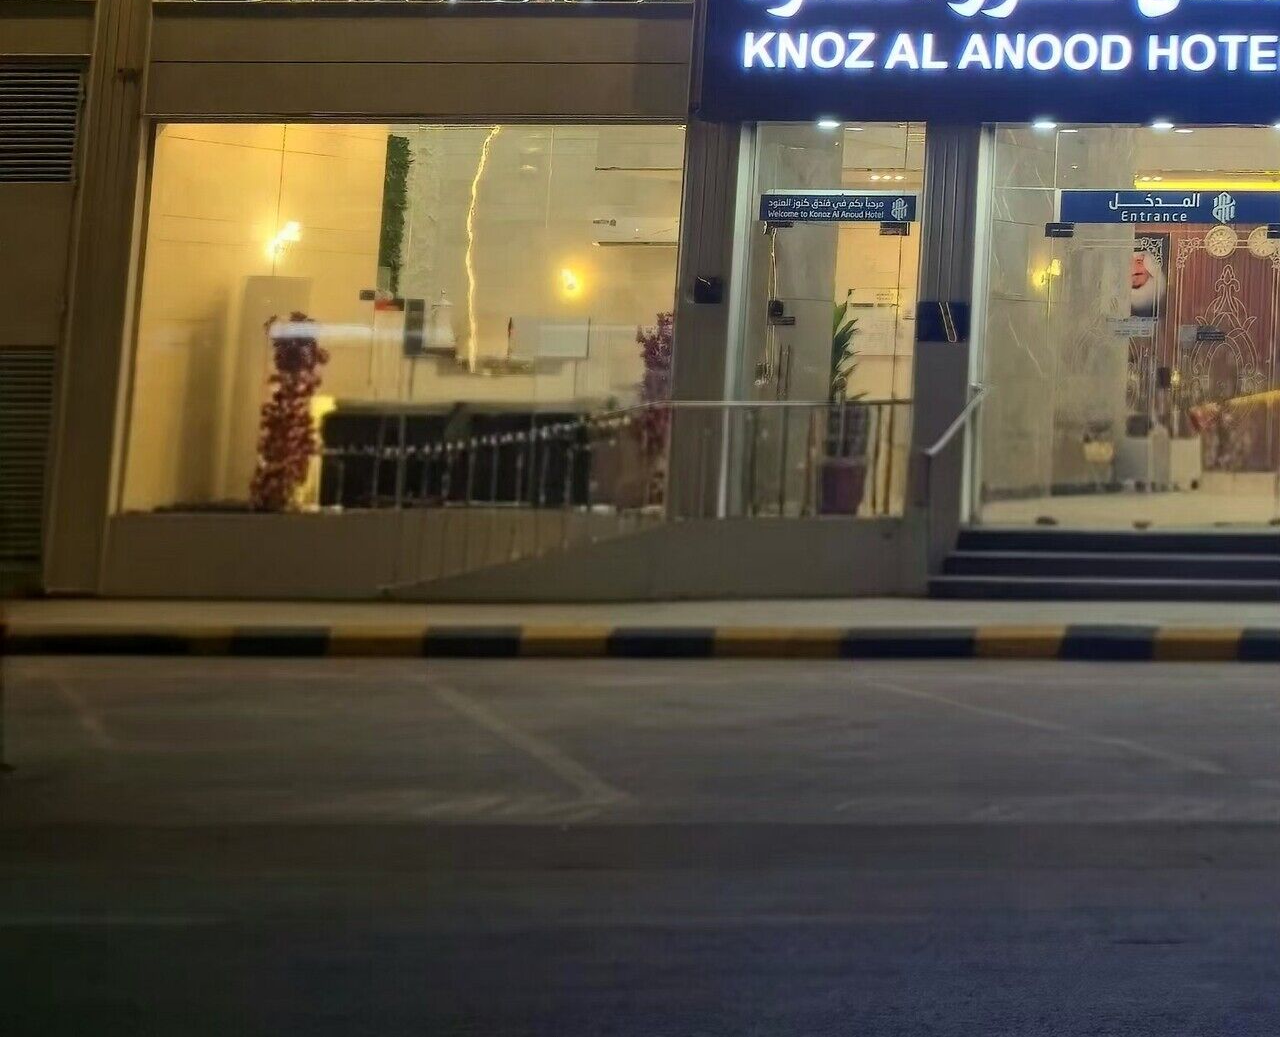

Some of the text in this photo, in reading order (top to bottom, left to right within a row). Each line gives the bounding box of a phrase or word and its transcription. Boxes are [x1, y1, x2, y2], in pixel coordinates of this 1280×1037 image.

[743, 32, 877, 70] KNOZ
[885, 34, 948, 70] AL
[958, 34, 1133, 71] ANOOD
[1109, 192, 1200, 209] المدخل
[768, 210, 799, 218] Welcome
[800, 210, 808, 218] to
[865, 210, 884, 219] Hotel
[1121, 211, 1188, 222] Entrance
